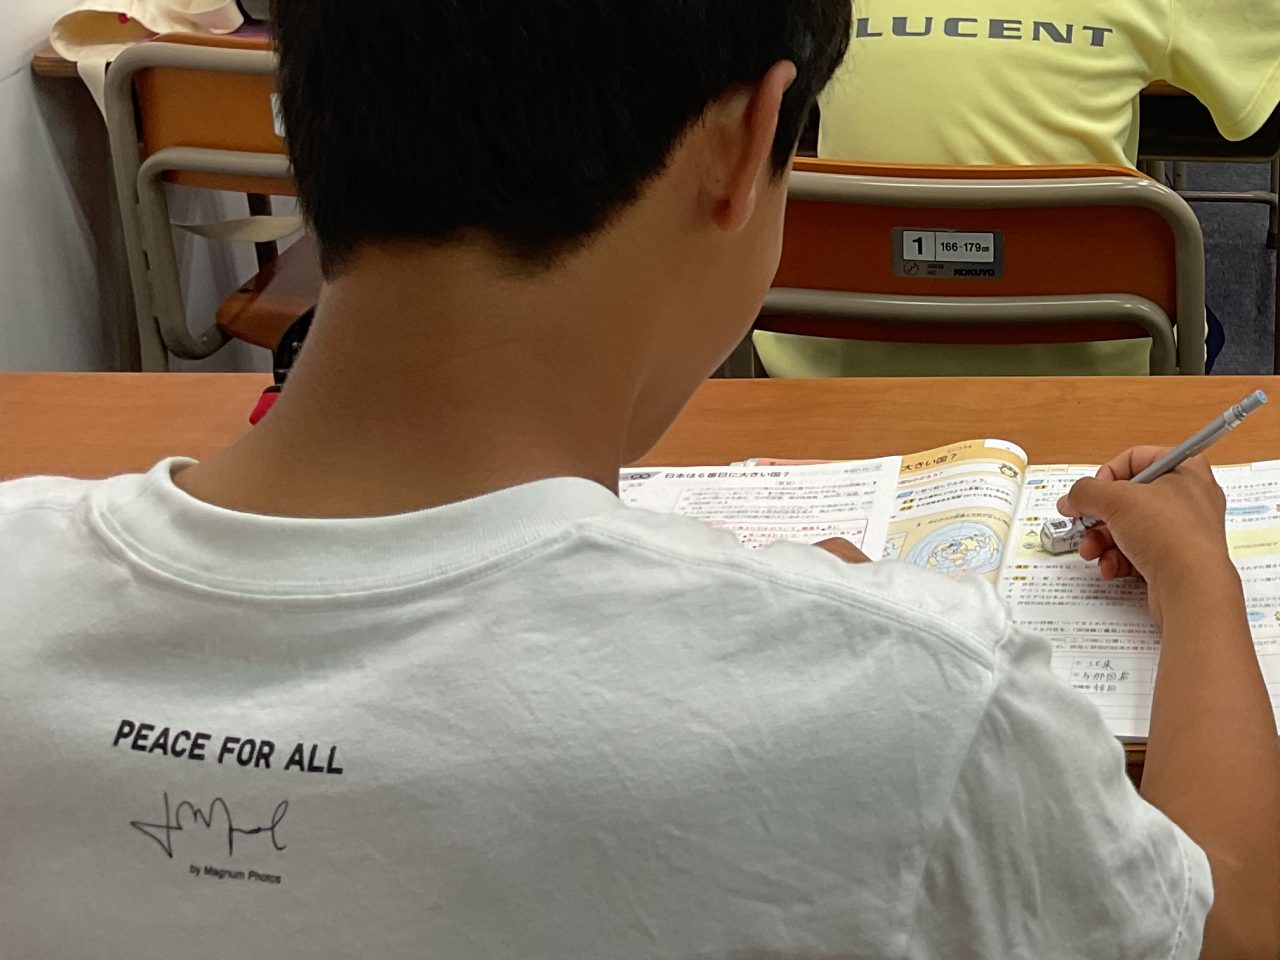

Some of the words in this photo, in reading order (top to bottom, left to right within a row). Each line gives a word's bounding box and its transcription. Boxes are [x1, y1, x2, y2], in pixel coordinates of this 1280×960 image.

[856, 16, 1114, 48] LUCENT
[912, 236, 923, 255] 1
[953, 268, 996, 277] KOKUYO
[112, 719, 212, 762] PEACE
[217, 736, 276, 769] FOR
[283, 743, 345, 775] ALL
[189, 863, 201, 877] by
[203, 866, 246, 881] Magnum
[247, 869, 282, 885] Photos
